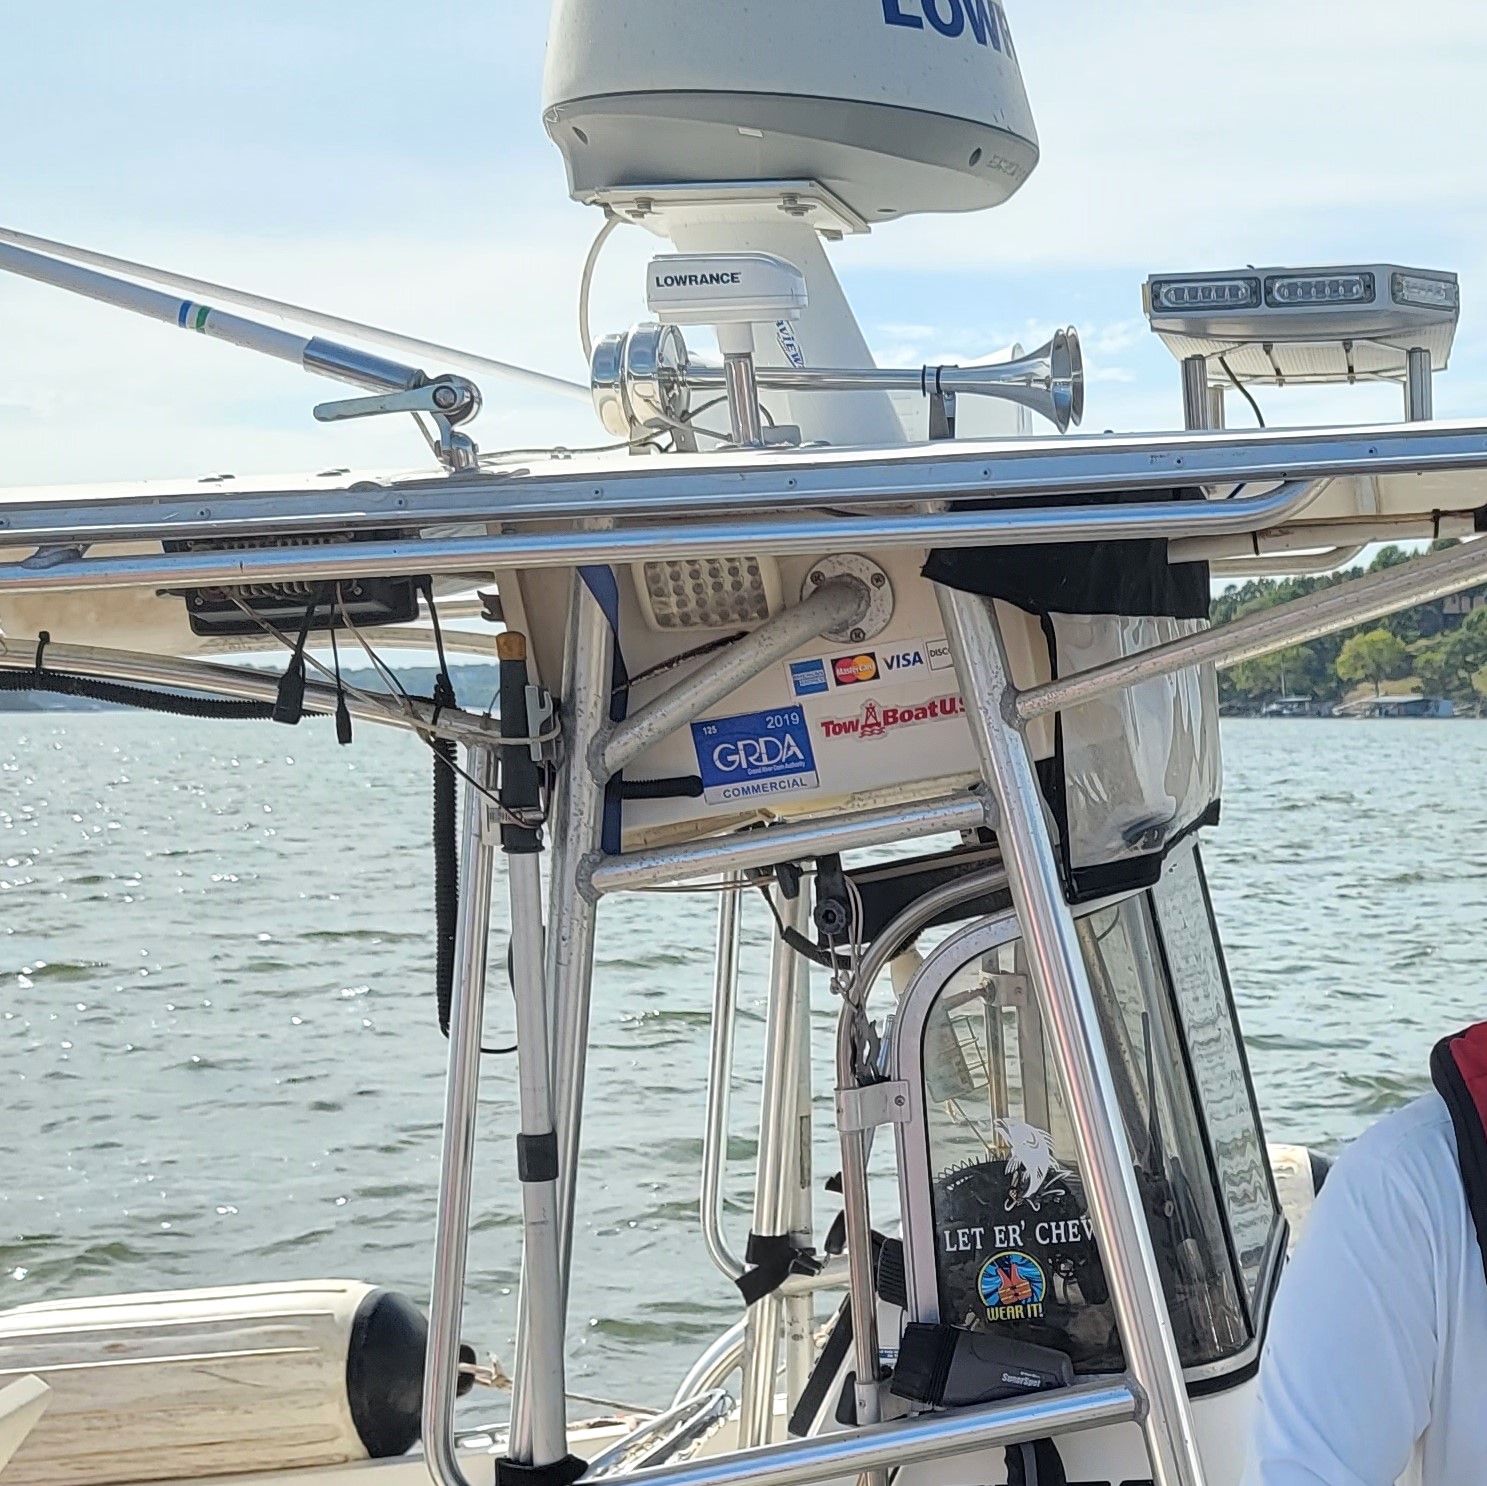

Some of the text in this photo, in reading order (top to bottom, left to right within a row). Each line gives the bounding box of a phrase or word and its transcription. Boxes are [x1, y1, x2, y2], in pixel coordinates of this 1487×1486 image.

[655, 272, 741, 288] LOWRANCE
[882, 651, 924, 671] VISA
[765, 712, 800, 729] 2019
[820, 718, 859, 738] Tow
[713, 733, 805, 772] GRDA
[722, 777, 808, 799] COMMERCIAL
[943, 1227, 985, 1252] LET
[993, 1219, 1026, 1249] ER'
[986, 1302, 1045, 1322] WEAR IT!
